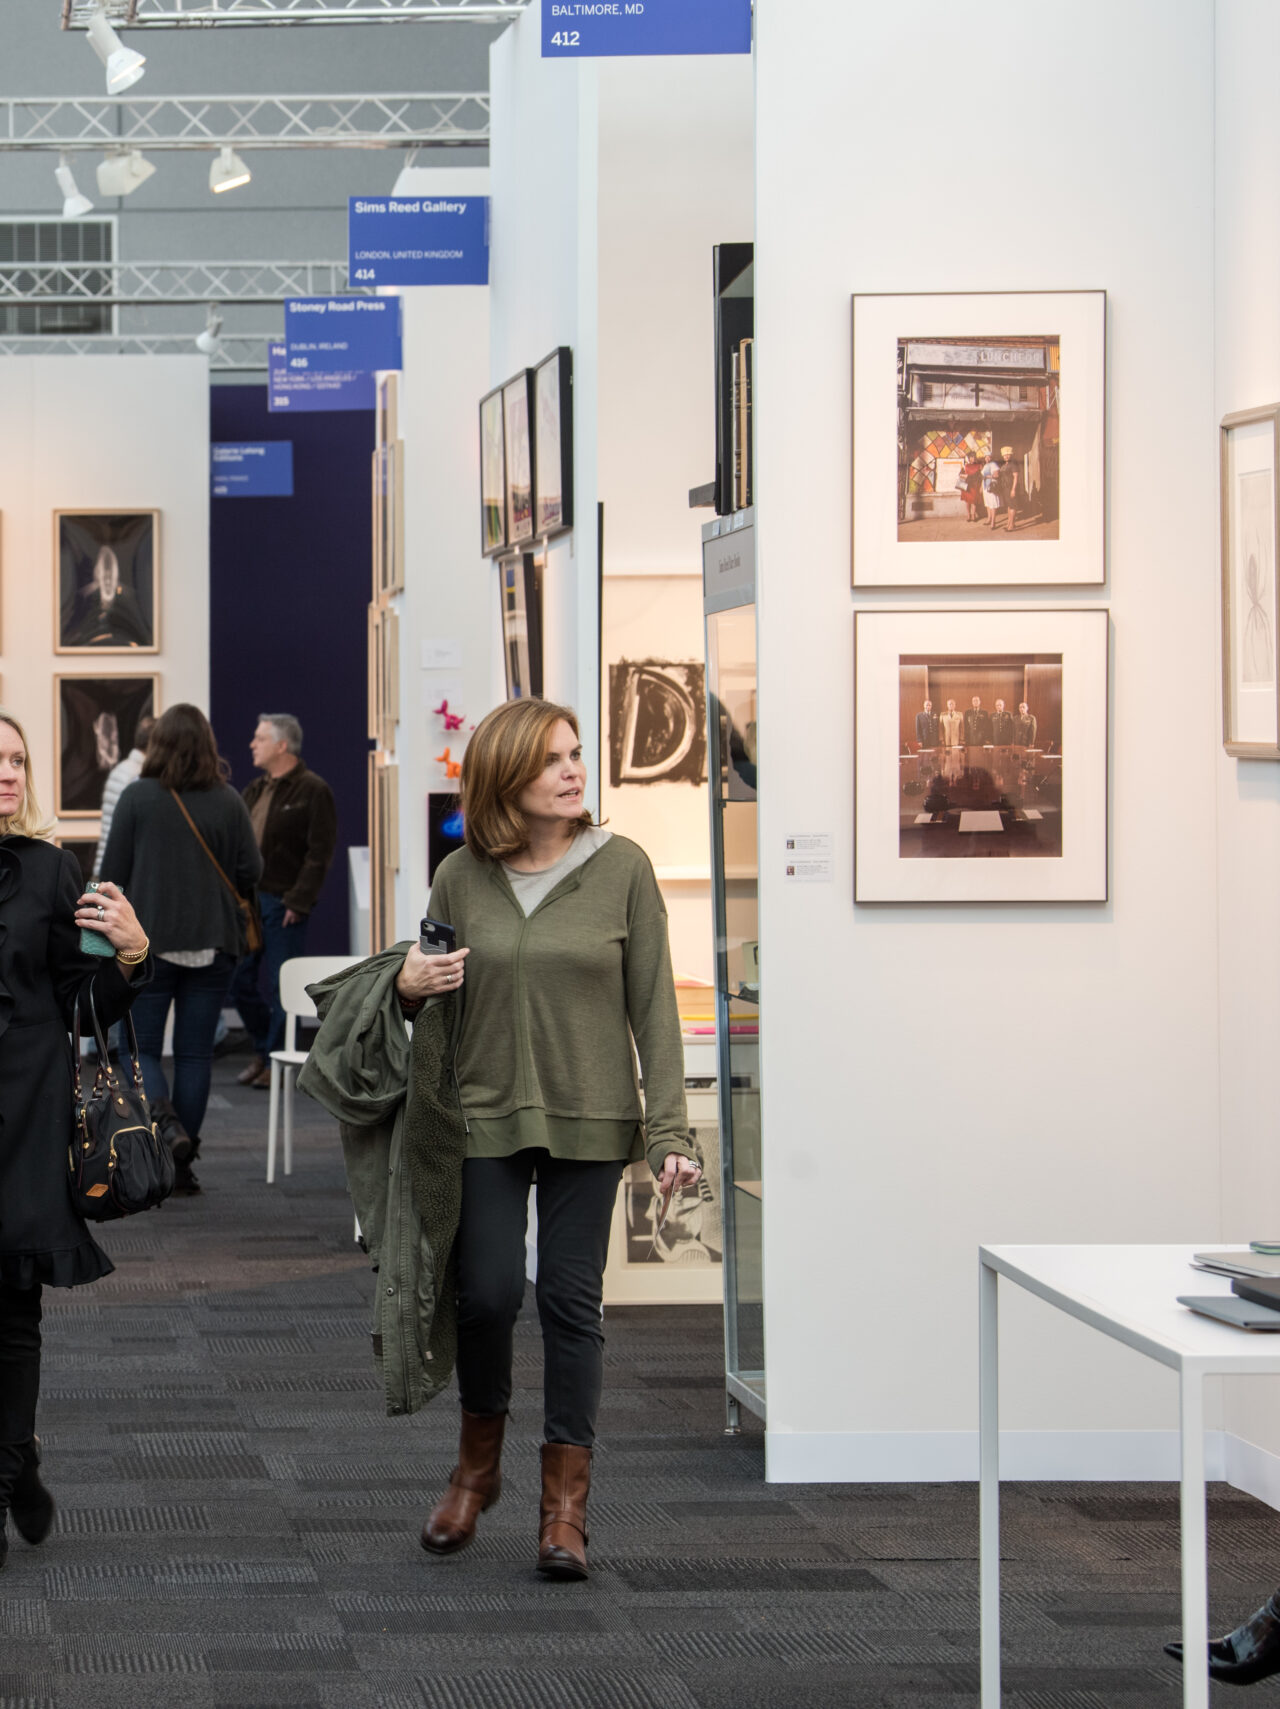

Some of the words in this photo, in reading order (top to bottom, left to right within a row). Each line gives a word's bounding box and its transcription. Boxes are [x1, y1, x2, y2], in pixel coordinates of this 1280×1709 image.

[551, 3, 623, 16] BALTIMORE,
[624, 3, 644, 15] MD
[550, 31, 580, 46] 412
[355, 201, 387, 214] Sims
[388, 201, 420, 213] Reed
[422, 200, 466, 214] Gallery
[355, 250, 391, 260] LONDON,
[392, 250, 423, 259] UNITED
[423, 250, 463, 259] KINGDOM
[354, 268, 376, 281] 414
[289, 302, 327, 314] Stoney
[327, 301, 355, 312] Road
[356, 300, 386, 311] Press
